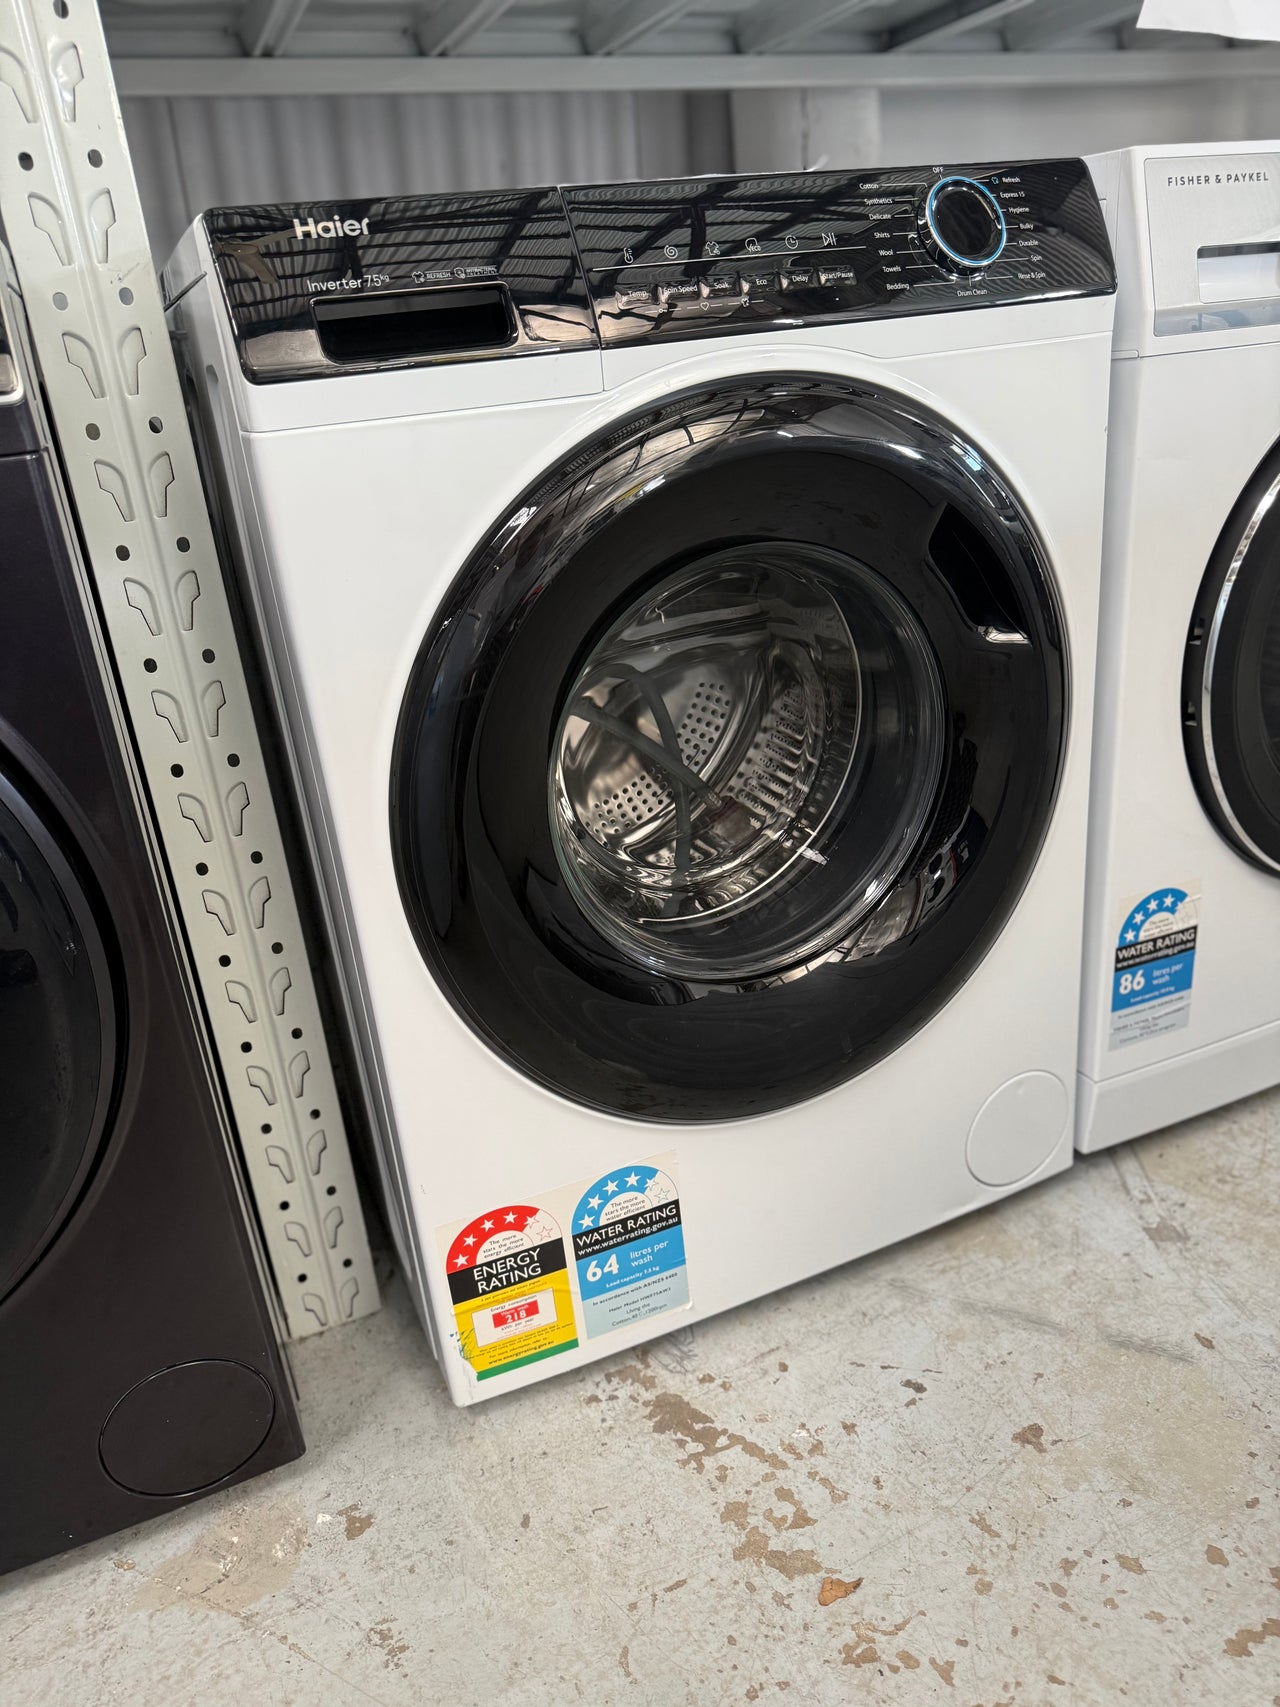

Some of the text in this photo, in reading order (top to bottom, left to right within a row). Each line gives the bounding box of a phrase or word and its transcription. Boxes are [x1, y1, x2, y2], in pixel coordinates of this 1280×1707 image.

[1167, 171, 1269, 187] FISHER & PAYKEL
[864, 198, 893, 206] Synthetics
[293, 215, 370, 240] Haier
[426, 271, 451, 279] REFRESH
[792, 275, 808, 283] Delay
[822, 272, 853, 280] Start/Pause
[306, 276, 362, 292] Inverter
[678, 285, 698, 293] Speed
[886, 283, 910, 291] Bedding
[1117, 929, 1195, 960] WATER RATING
[1119, 969, 1146, 995] 86
[622, 1196, 638, 1204] more
[630, 1199, 646, 1207] more
[606, 1204, 646, 1222] water efficient
[576, 1204, 677, 1247] WATER RATING
[577, 1217, 679, 1256] www.waterrating.gov.au
[484, 1242, 525, 1259] energy efficient
[629, 1240, 669, 1259] litres per
[473, 1248, 541, 1280] ENERGY
[586, 1253, 620, 1282] 64
[630, 1254, 653, 1267] wash
[477, 1263, 542, 1294] RATING
[605, 1280, 620, 1288] Load
[620, 1272, 643, 1283] capacity
[491, 1295, 537, 1313] Energy consumption
[623, 1299, 640, 1307] Model
[505, 1310, 527, 1323] 218
